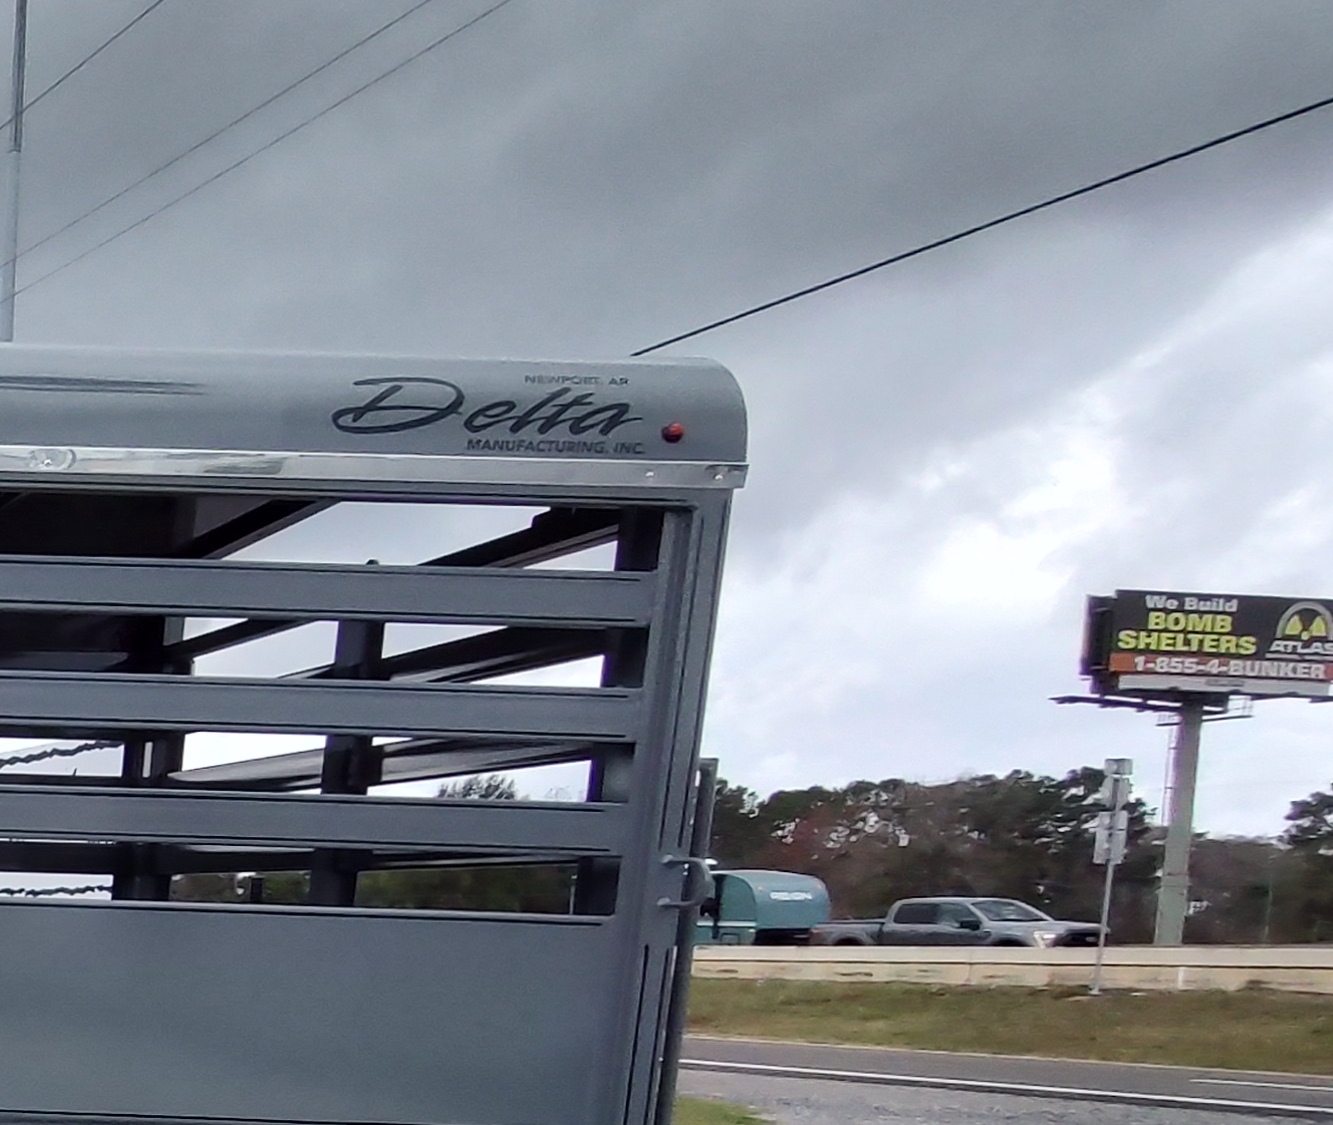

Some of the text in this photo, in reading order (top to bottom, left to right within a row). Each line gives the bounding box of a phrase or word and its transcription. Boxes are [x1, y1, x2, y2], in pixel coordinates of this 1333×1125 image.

[331, 377, 644, 436] Delta
[1145, 594, 1239, 613] We Build
[1147, 611, 1234, 633] BOMB
[1117, 630, 1258, 655] SHELTERS
[1133, 655, 1326, 680] 1-855-4-BUNKER
